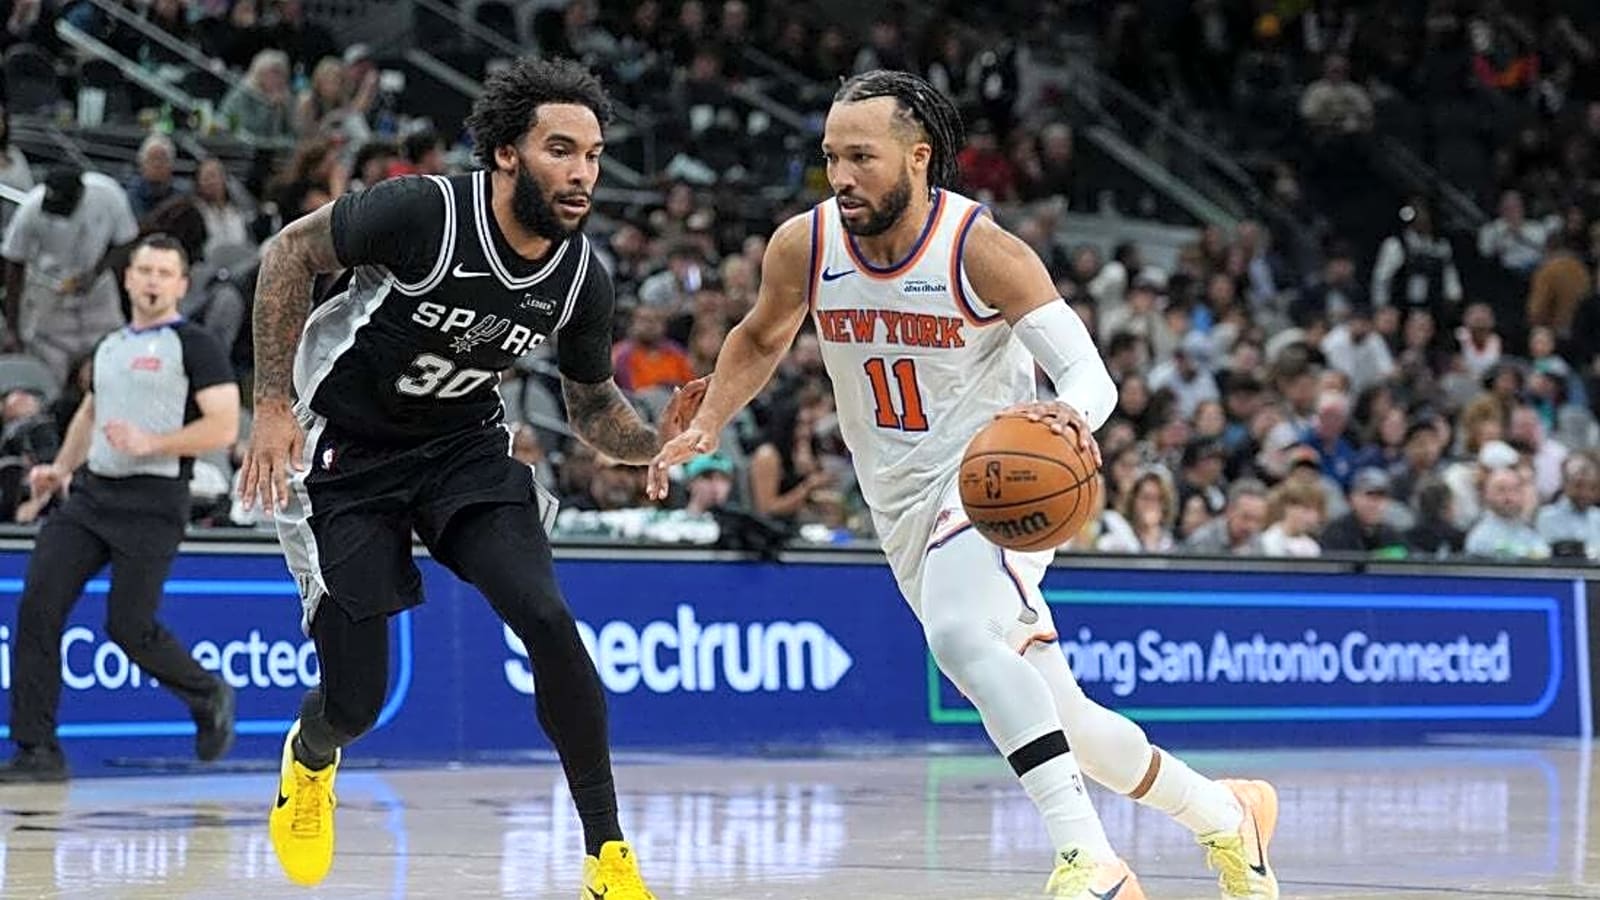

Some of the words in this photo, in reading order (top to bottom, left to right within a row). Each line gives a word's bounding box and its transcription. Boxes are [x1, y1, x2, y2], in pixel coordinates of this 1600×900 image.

[816, 308, 877, 344] NEW
[879, 310, 966, 349] YORK
[395, 352, 496, 399] 30
[863, 357, 930, 432] 11
[1138, 629, 1204, 683] San
[1206, 628, 1341, 683] Antonio
[1341, 630, 1511, 683] Connected
